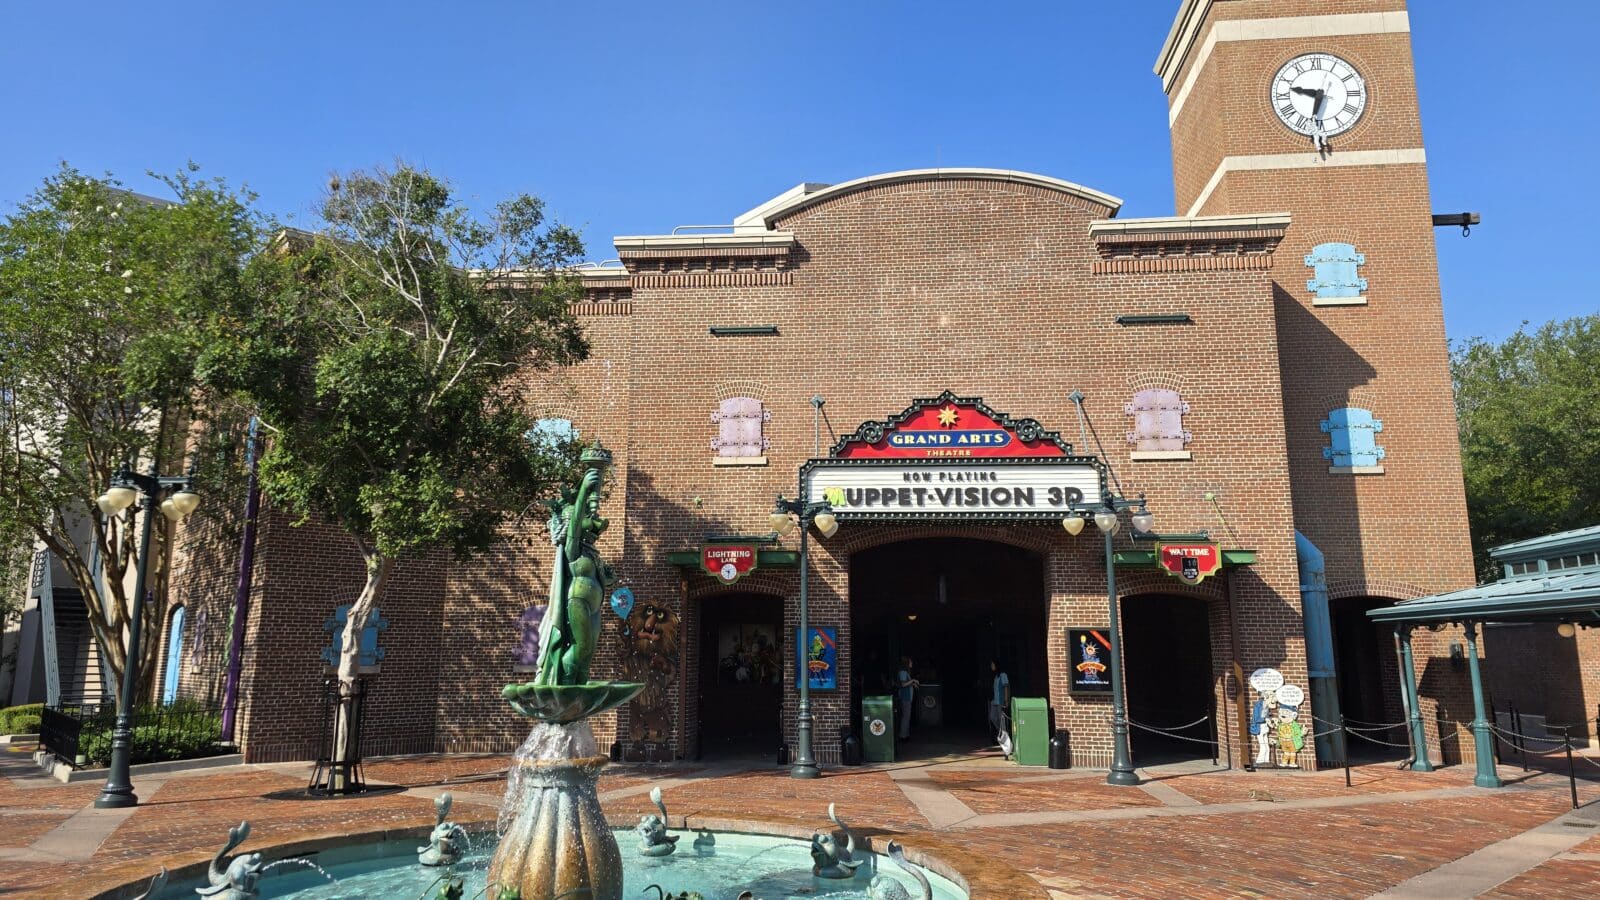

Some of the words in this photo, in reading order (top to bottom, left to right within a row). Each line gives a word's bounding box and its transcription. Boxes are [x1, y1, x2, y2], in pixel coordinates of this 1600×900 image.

[892, 434, 951, 444] GRAND
[958, 433, 1004, 443] ARTS
[903, 472, 931, 482] NOW
[939, 472, 997, 482] PLAYING
[1047, 486, 1084, 507] 3D
[707, 550, 751, 558] LIGHTNING
[1169, 548, 1188, 556] WAIT
[1190, 548, 1210, 556] TIME
